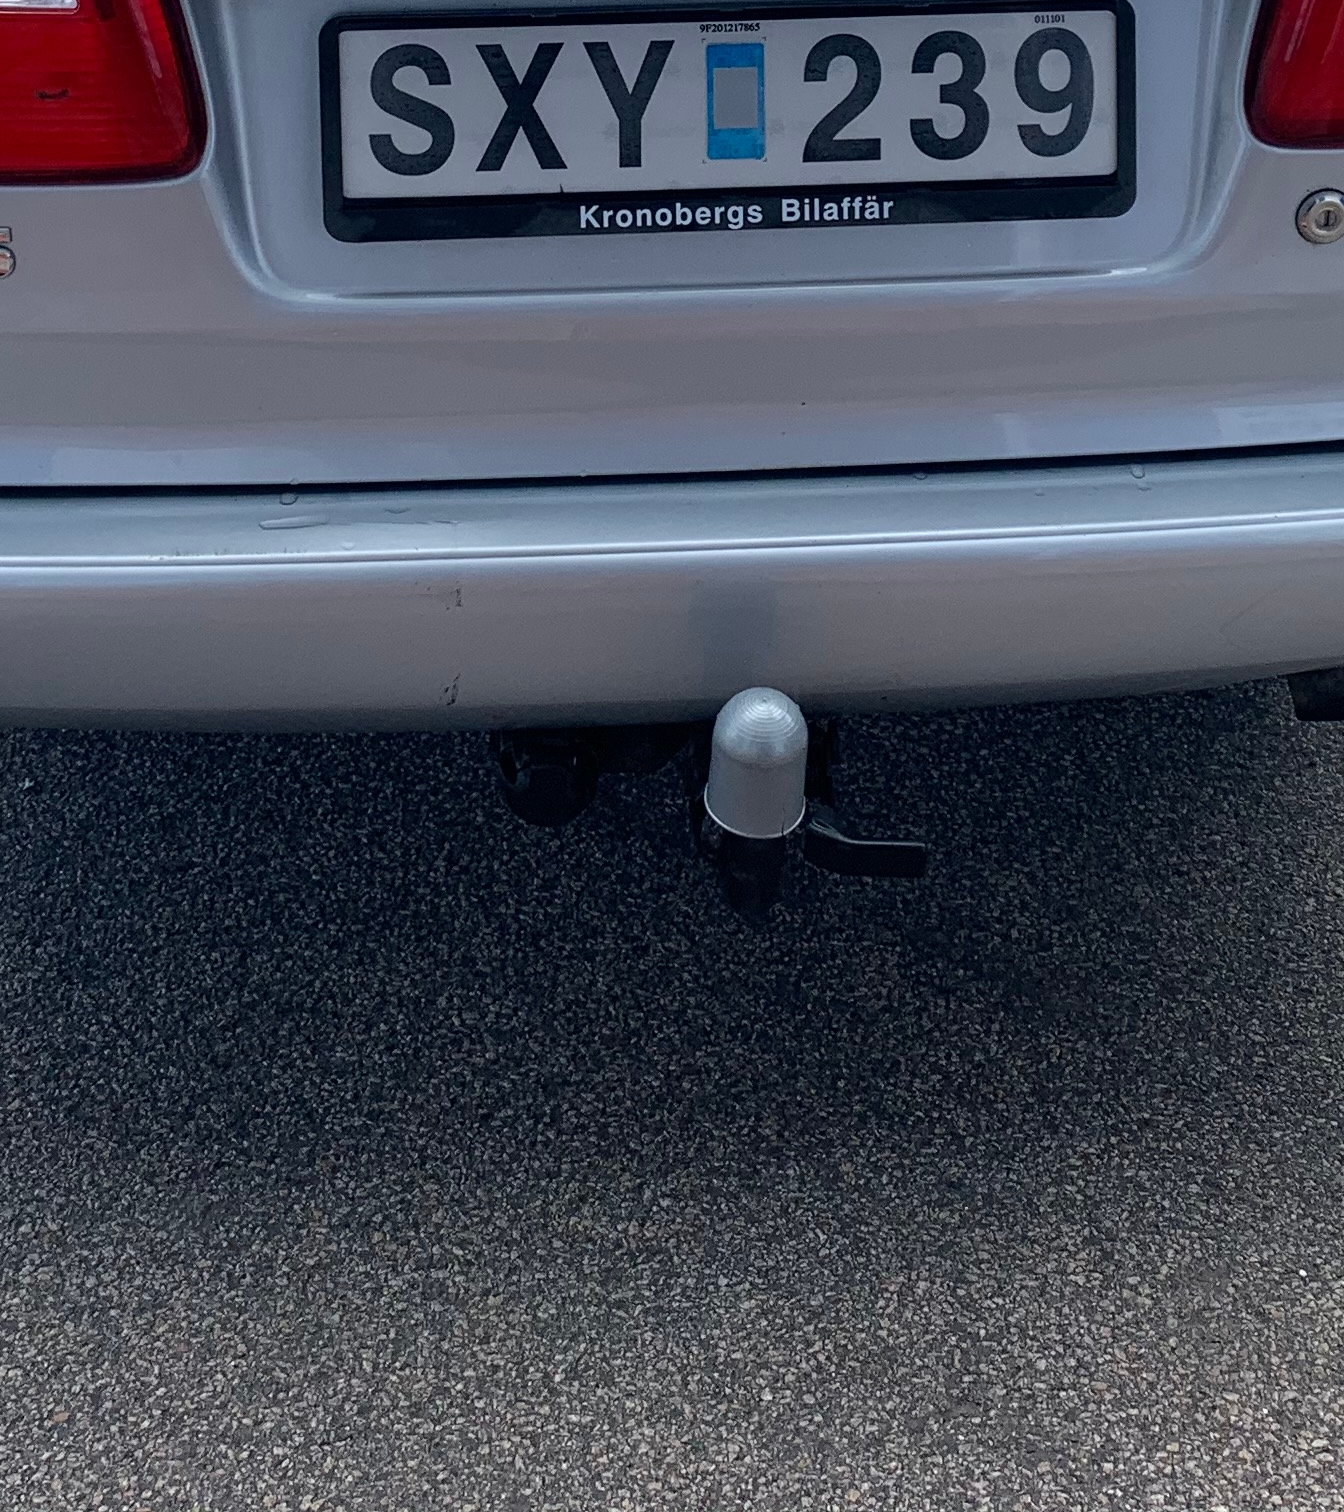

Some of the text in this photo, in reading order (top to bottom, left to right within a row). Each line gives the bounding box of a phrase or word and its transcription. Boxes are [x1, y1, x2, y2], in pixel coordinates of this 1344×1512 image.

[368, 26, 1094, 178] SXY 239
[579, 195, 895, 230] Kronobergs Bilaffär
